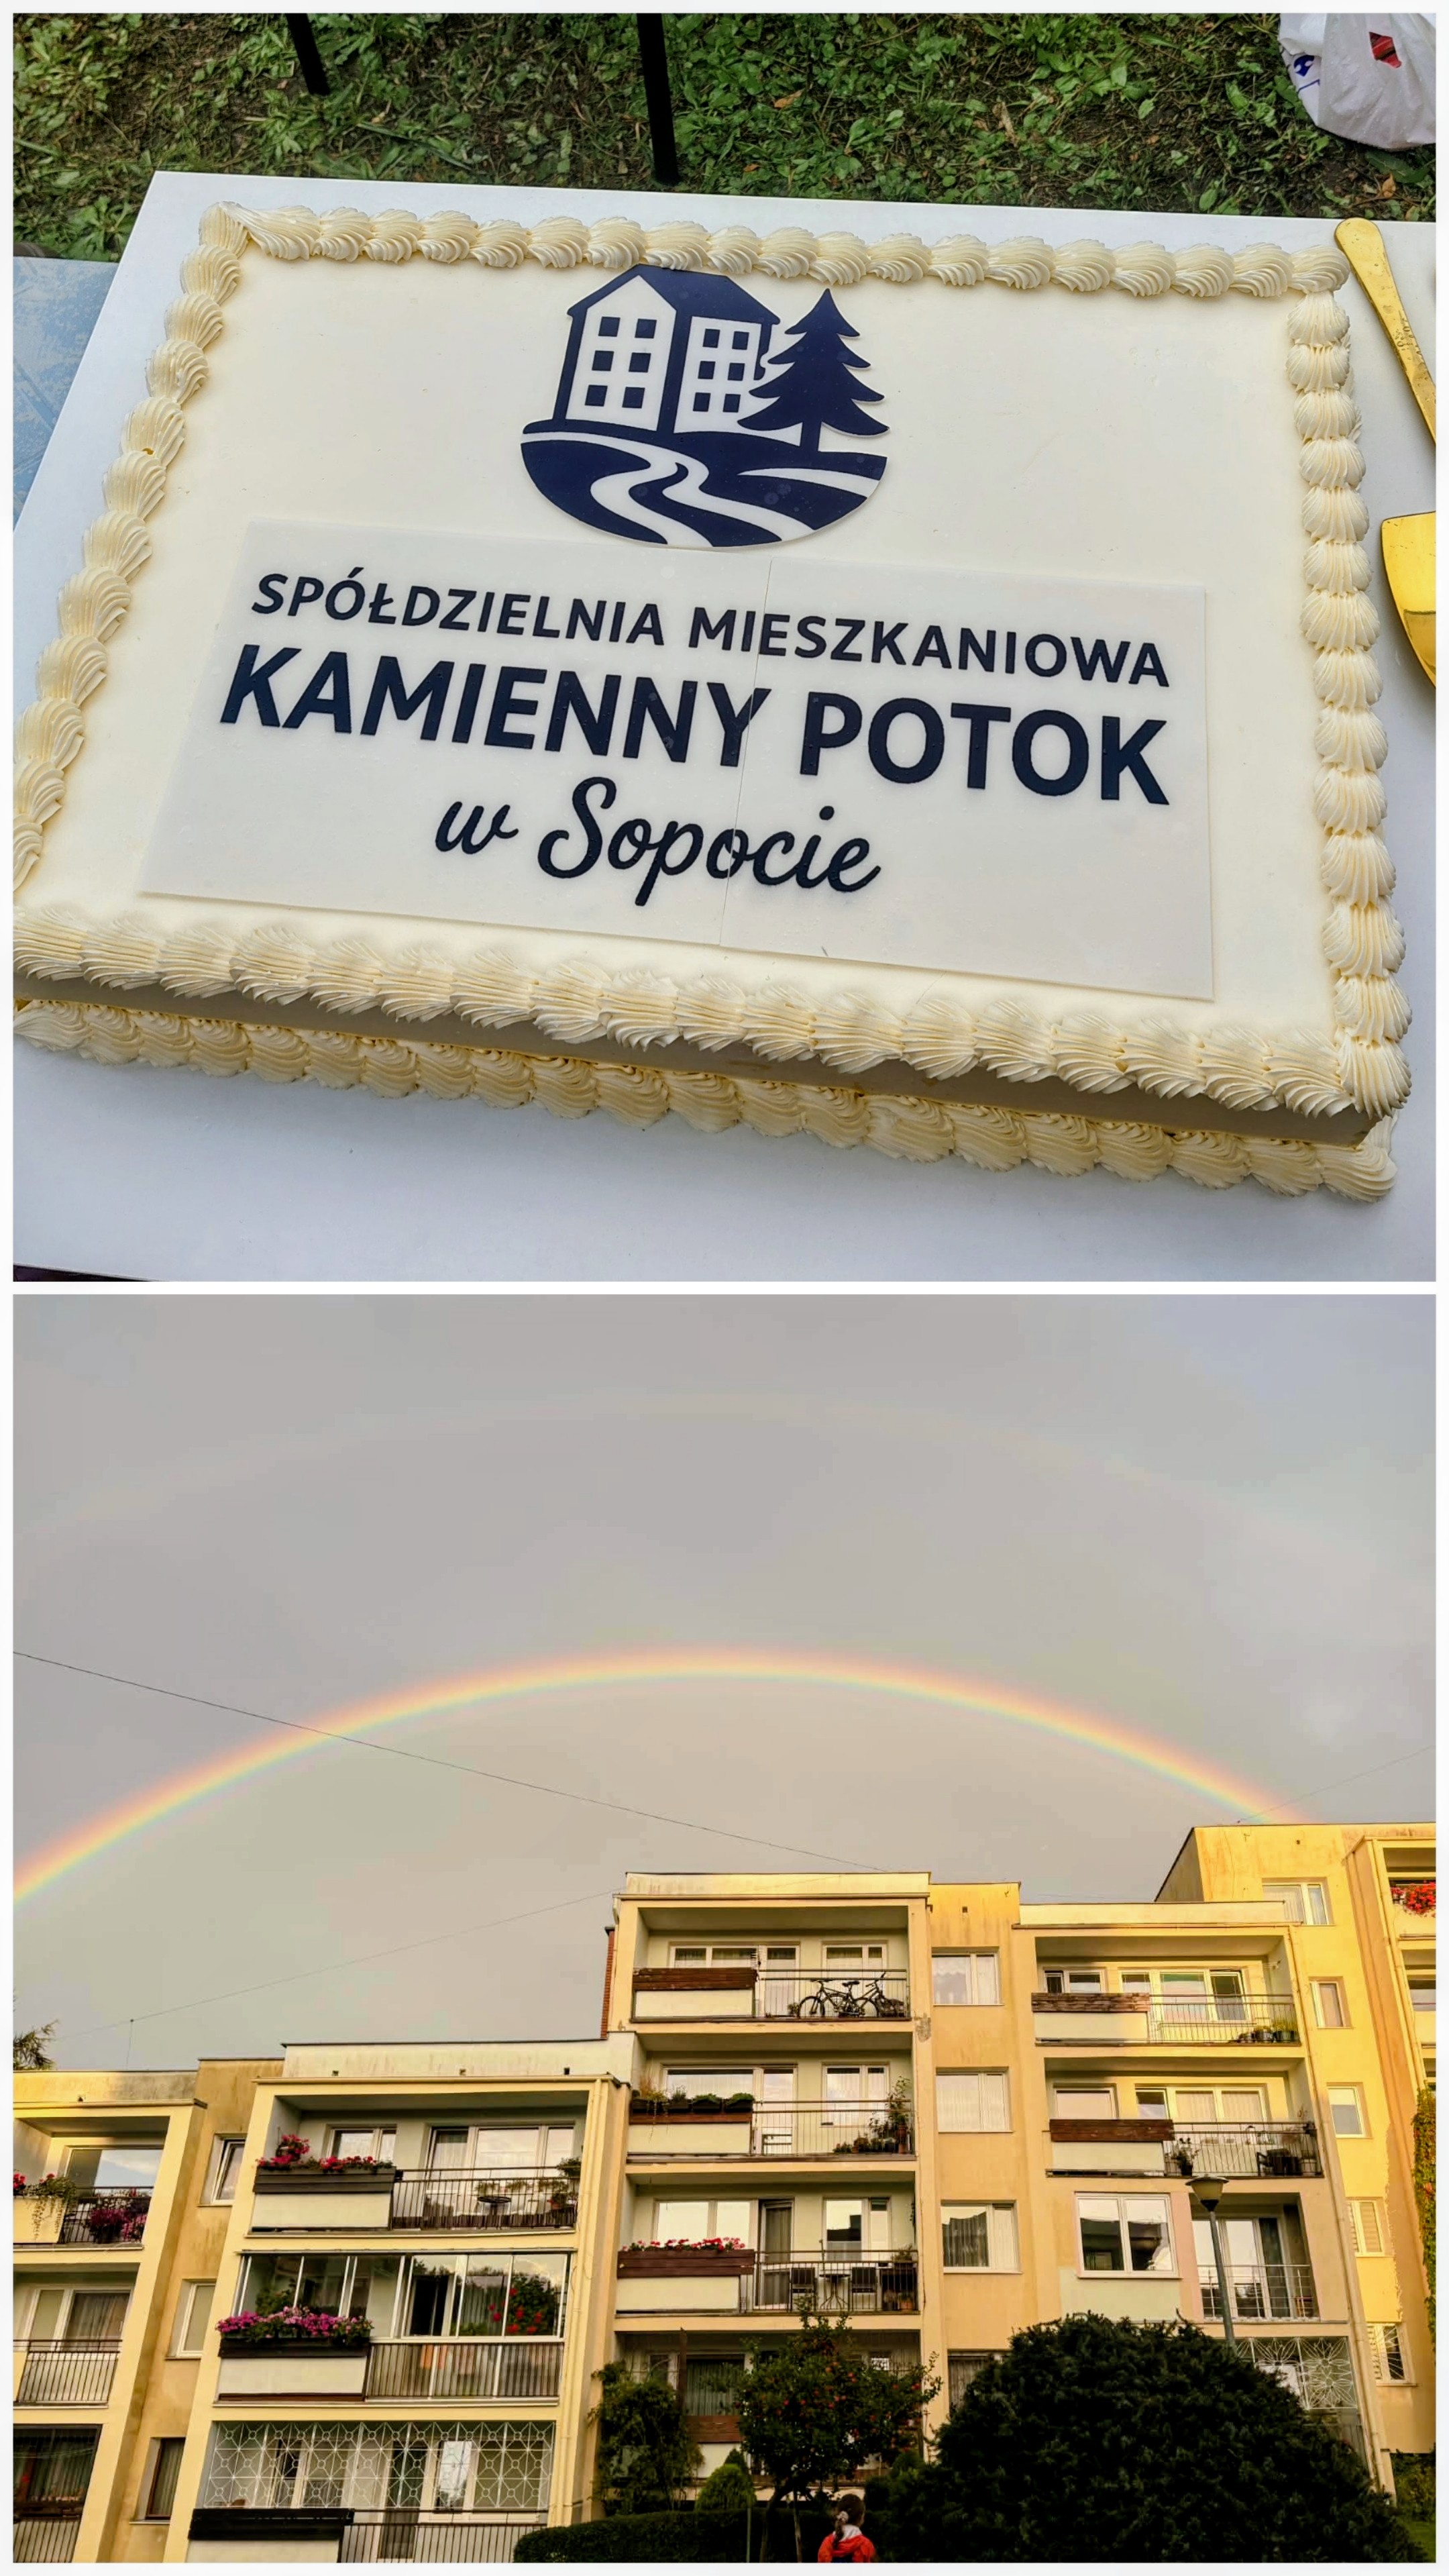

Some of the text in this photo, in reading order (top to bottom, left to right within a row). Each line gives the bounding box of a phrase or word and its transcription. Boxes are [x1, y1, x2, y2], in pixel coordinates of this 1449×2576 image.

[252, 567, 1169, 687] SPÓŁDZIELNIA MIESZKANIOWA
[220, 644, 1169, 805] KAMIENNY POTOK
[435, 777, 881, 906] w Sopocie
